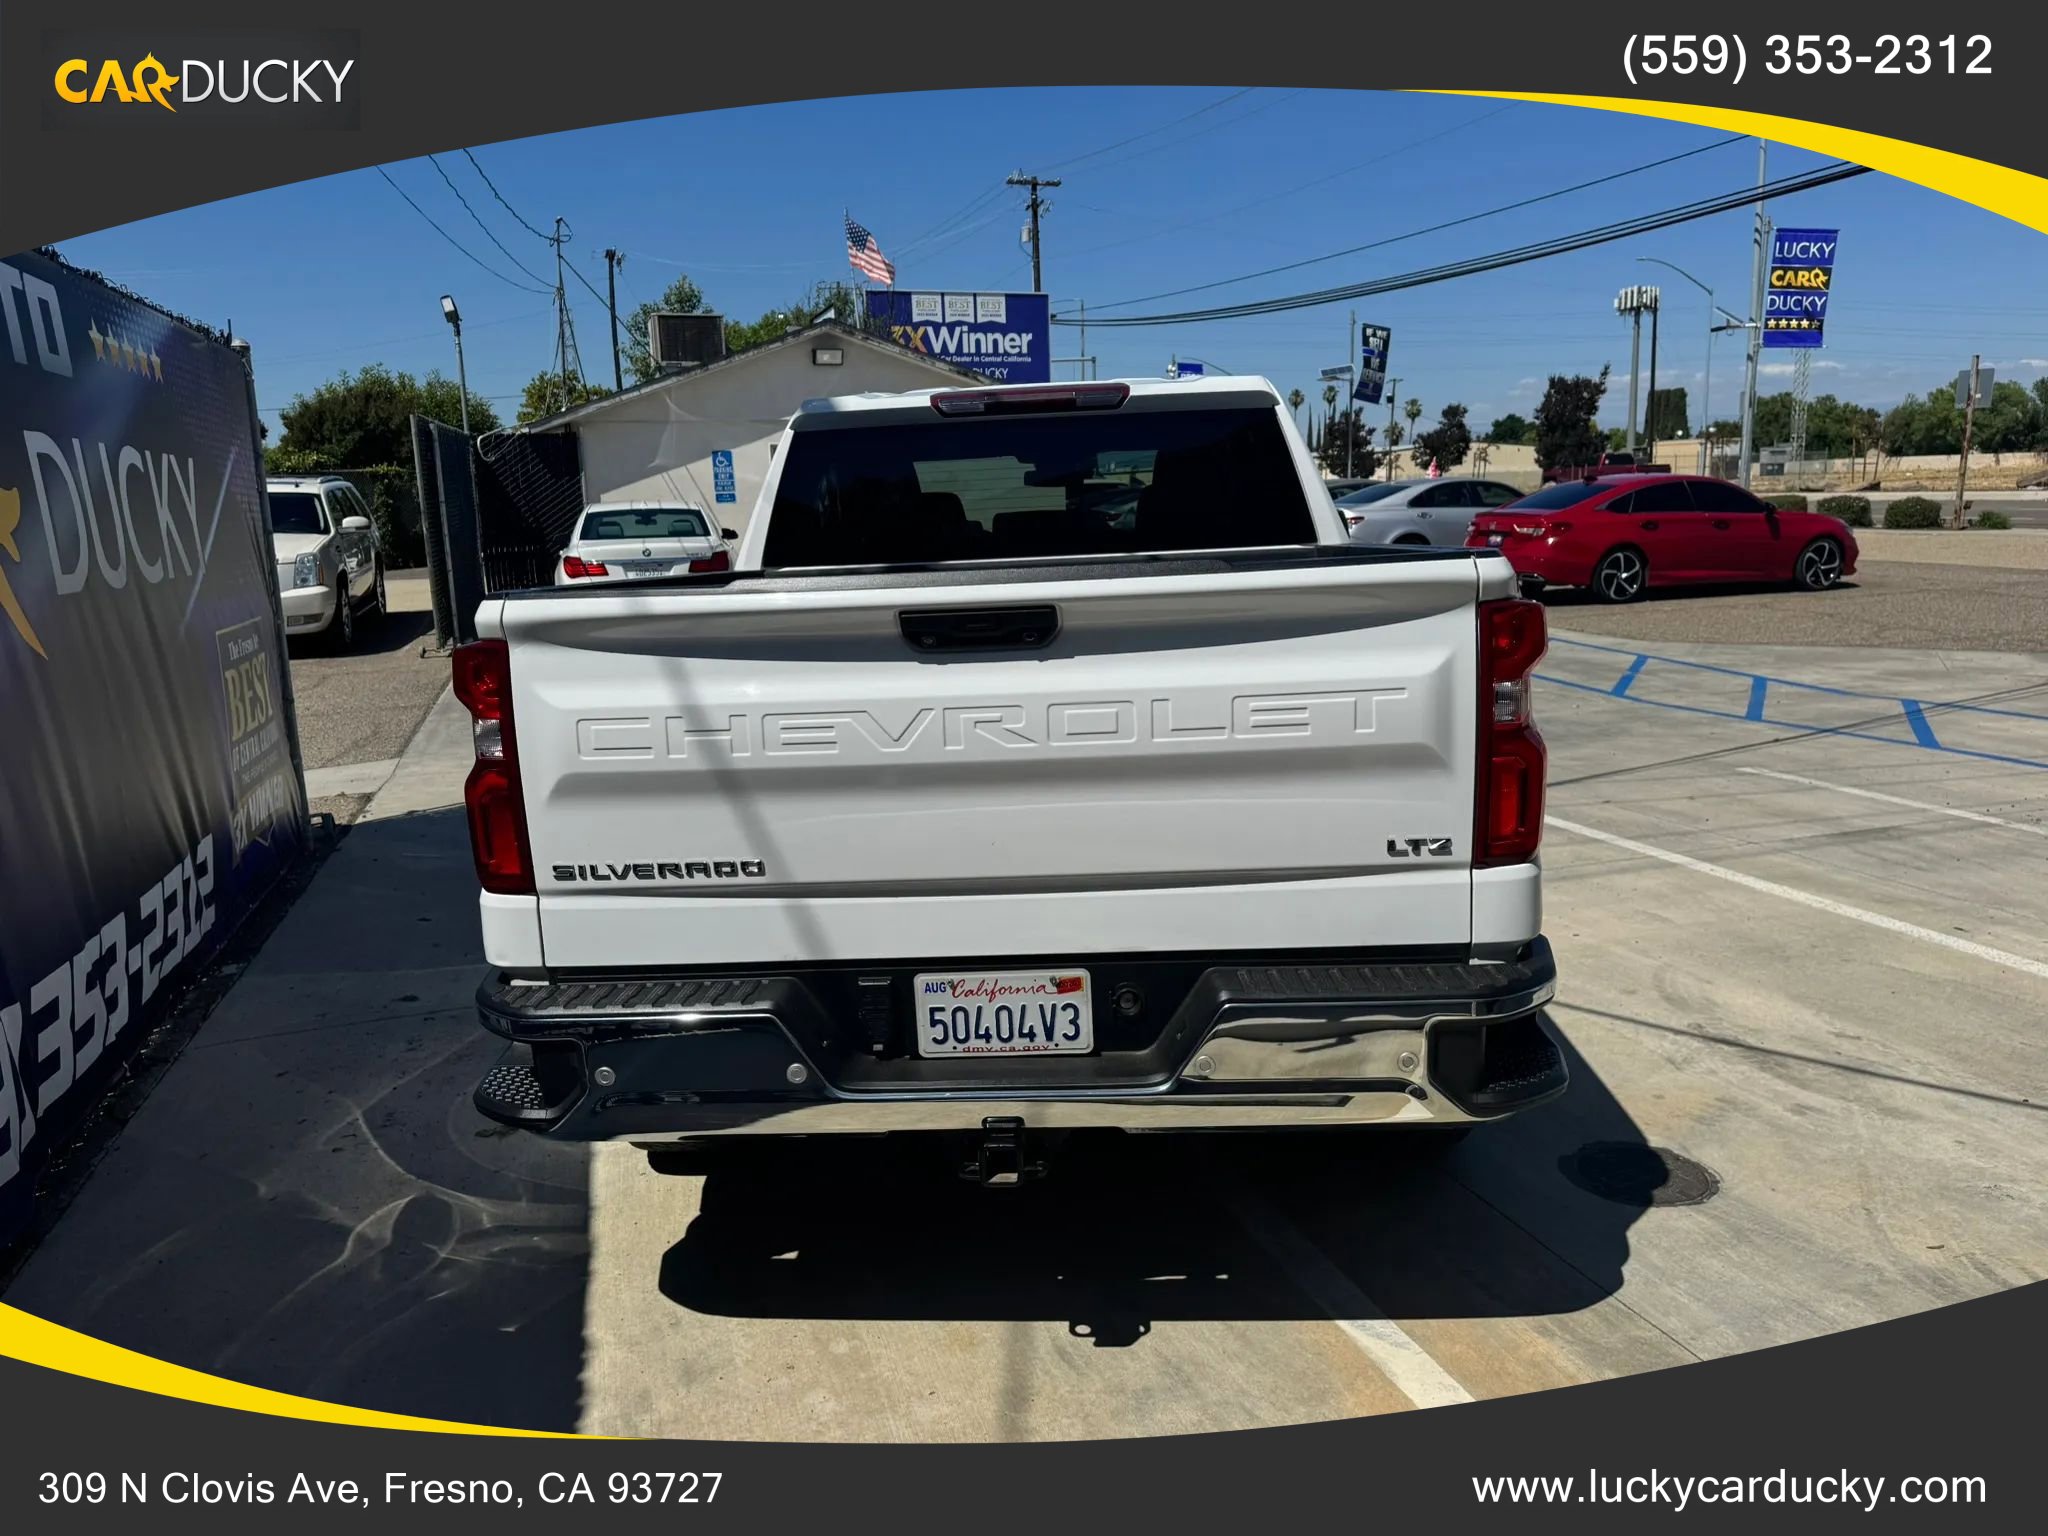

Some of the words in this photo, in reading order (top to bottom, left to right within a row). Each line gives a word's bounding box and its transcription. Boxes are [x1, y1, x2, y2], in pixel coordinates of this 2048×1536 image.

[1775, 241, 1835, 259] LUCKY
[915, 300, 938, 309] BEST
[1766, 295, 1827, 312] DUCKY
[23, 430, 206, 596] DUCKY
[225, 652, 273, 741] BEST
[575, 687, 1409, 760] CHEVROLET
[1386, 837, 1453, 858] LTZ
[552, 858, 766, 882] SILVERADO
[924, 981, 947, 994] AUG
[951, 978, 1052, 1004] California
[928, 1002, 1082, 1046] 50404V3
